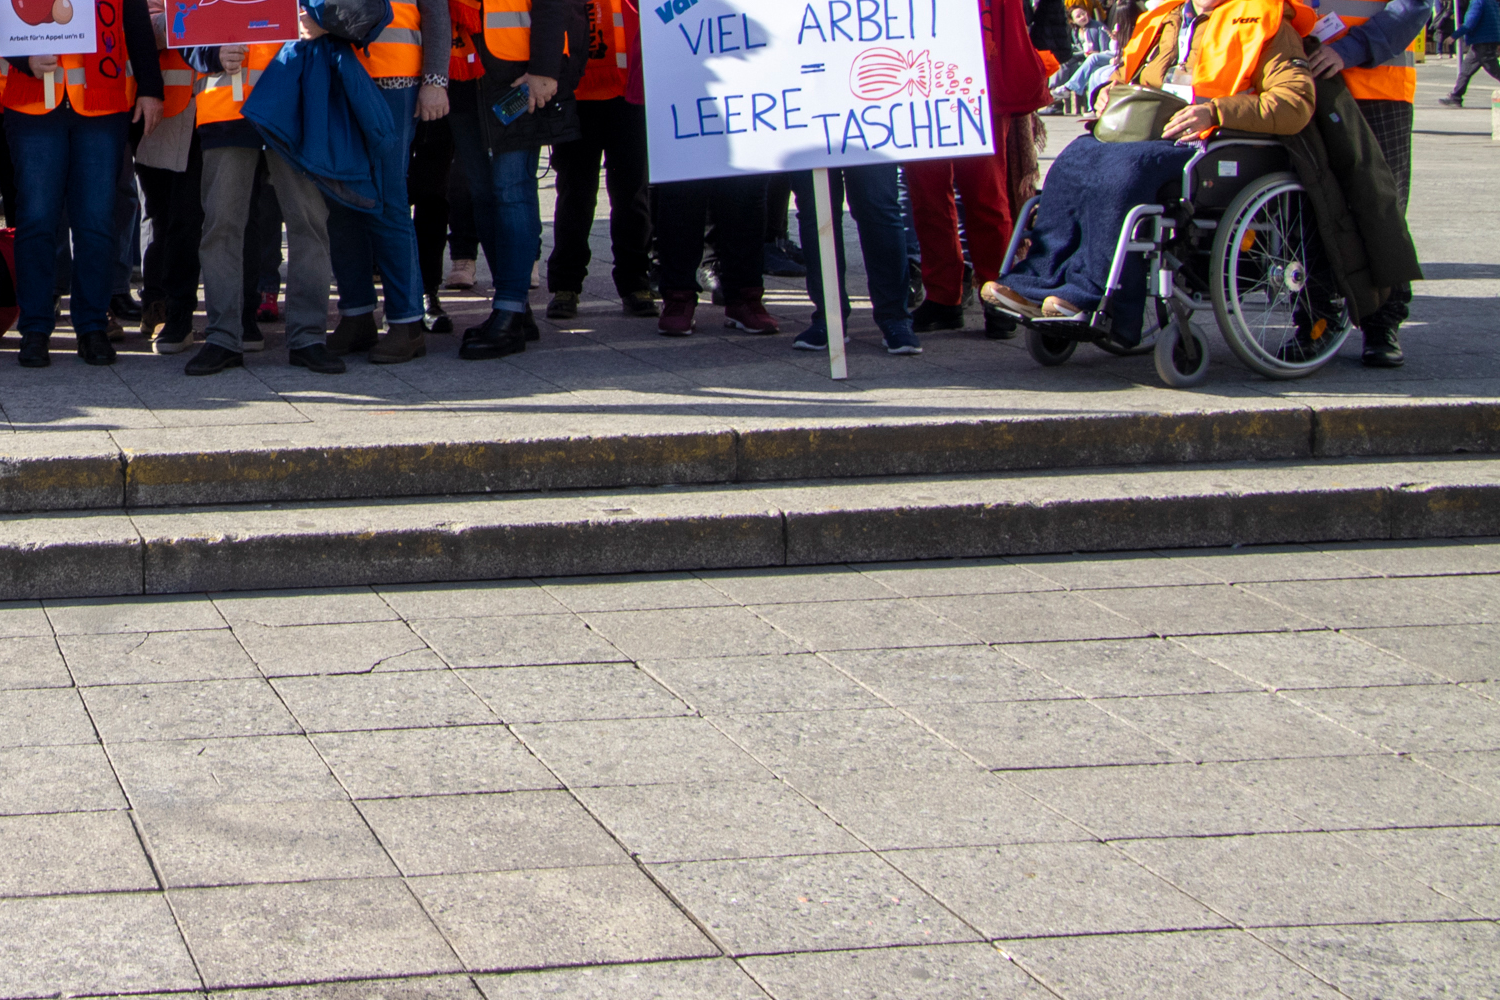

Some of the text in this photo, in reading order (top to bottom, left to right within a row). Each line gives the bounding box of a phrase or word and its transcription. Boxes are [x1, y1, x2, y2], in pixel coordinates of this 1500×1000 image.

[679, 13, 767, 55] VIEL
[1232, 17, 1261, 25] VdK
[671, 88, 987, 155] LEERE TASCHEN
